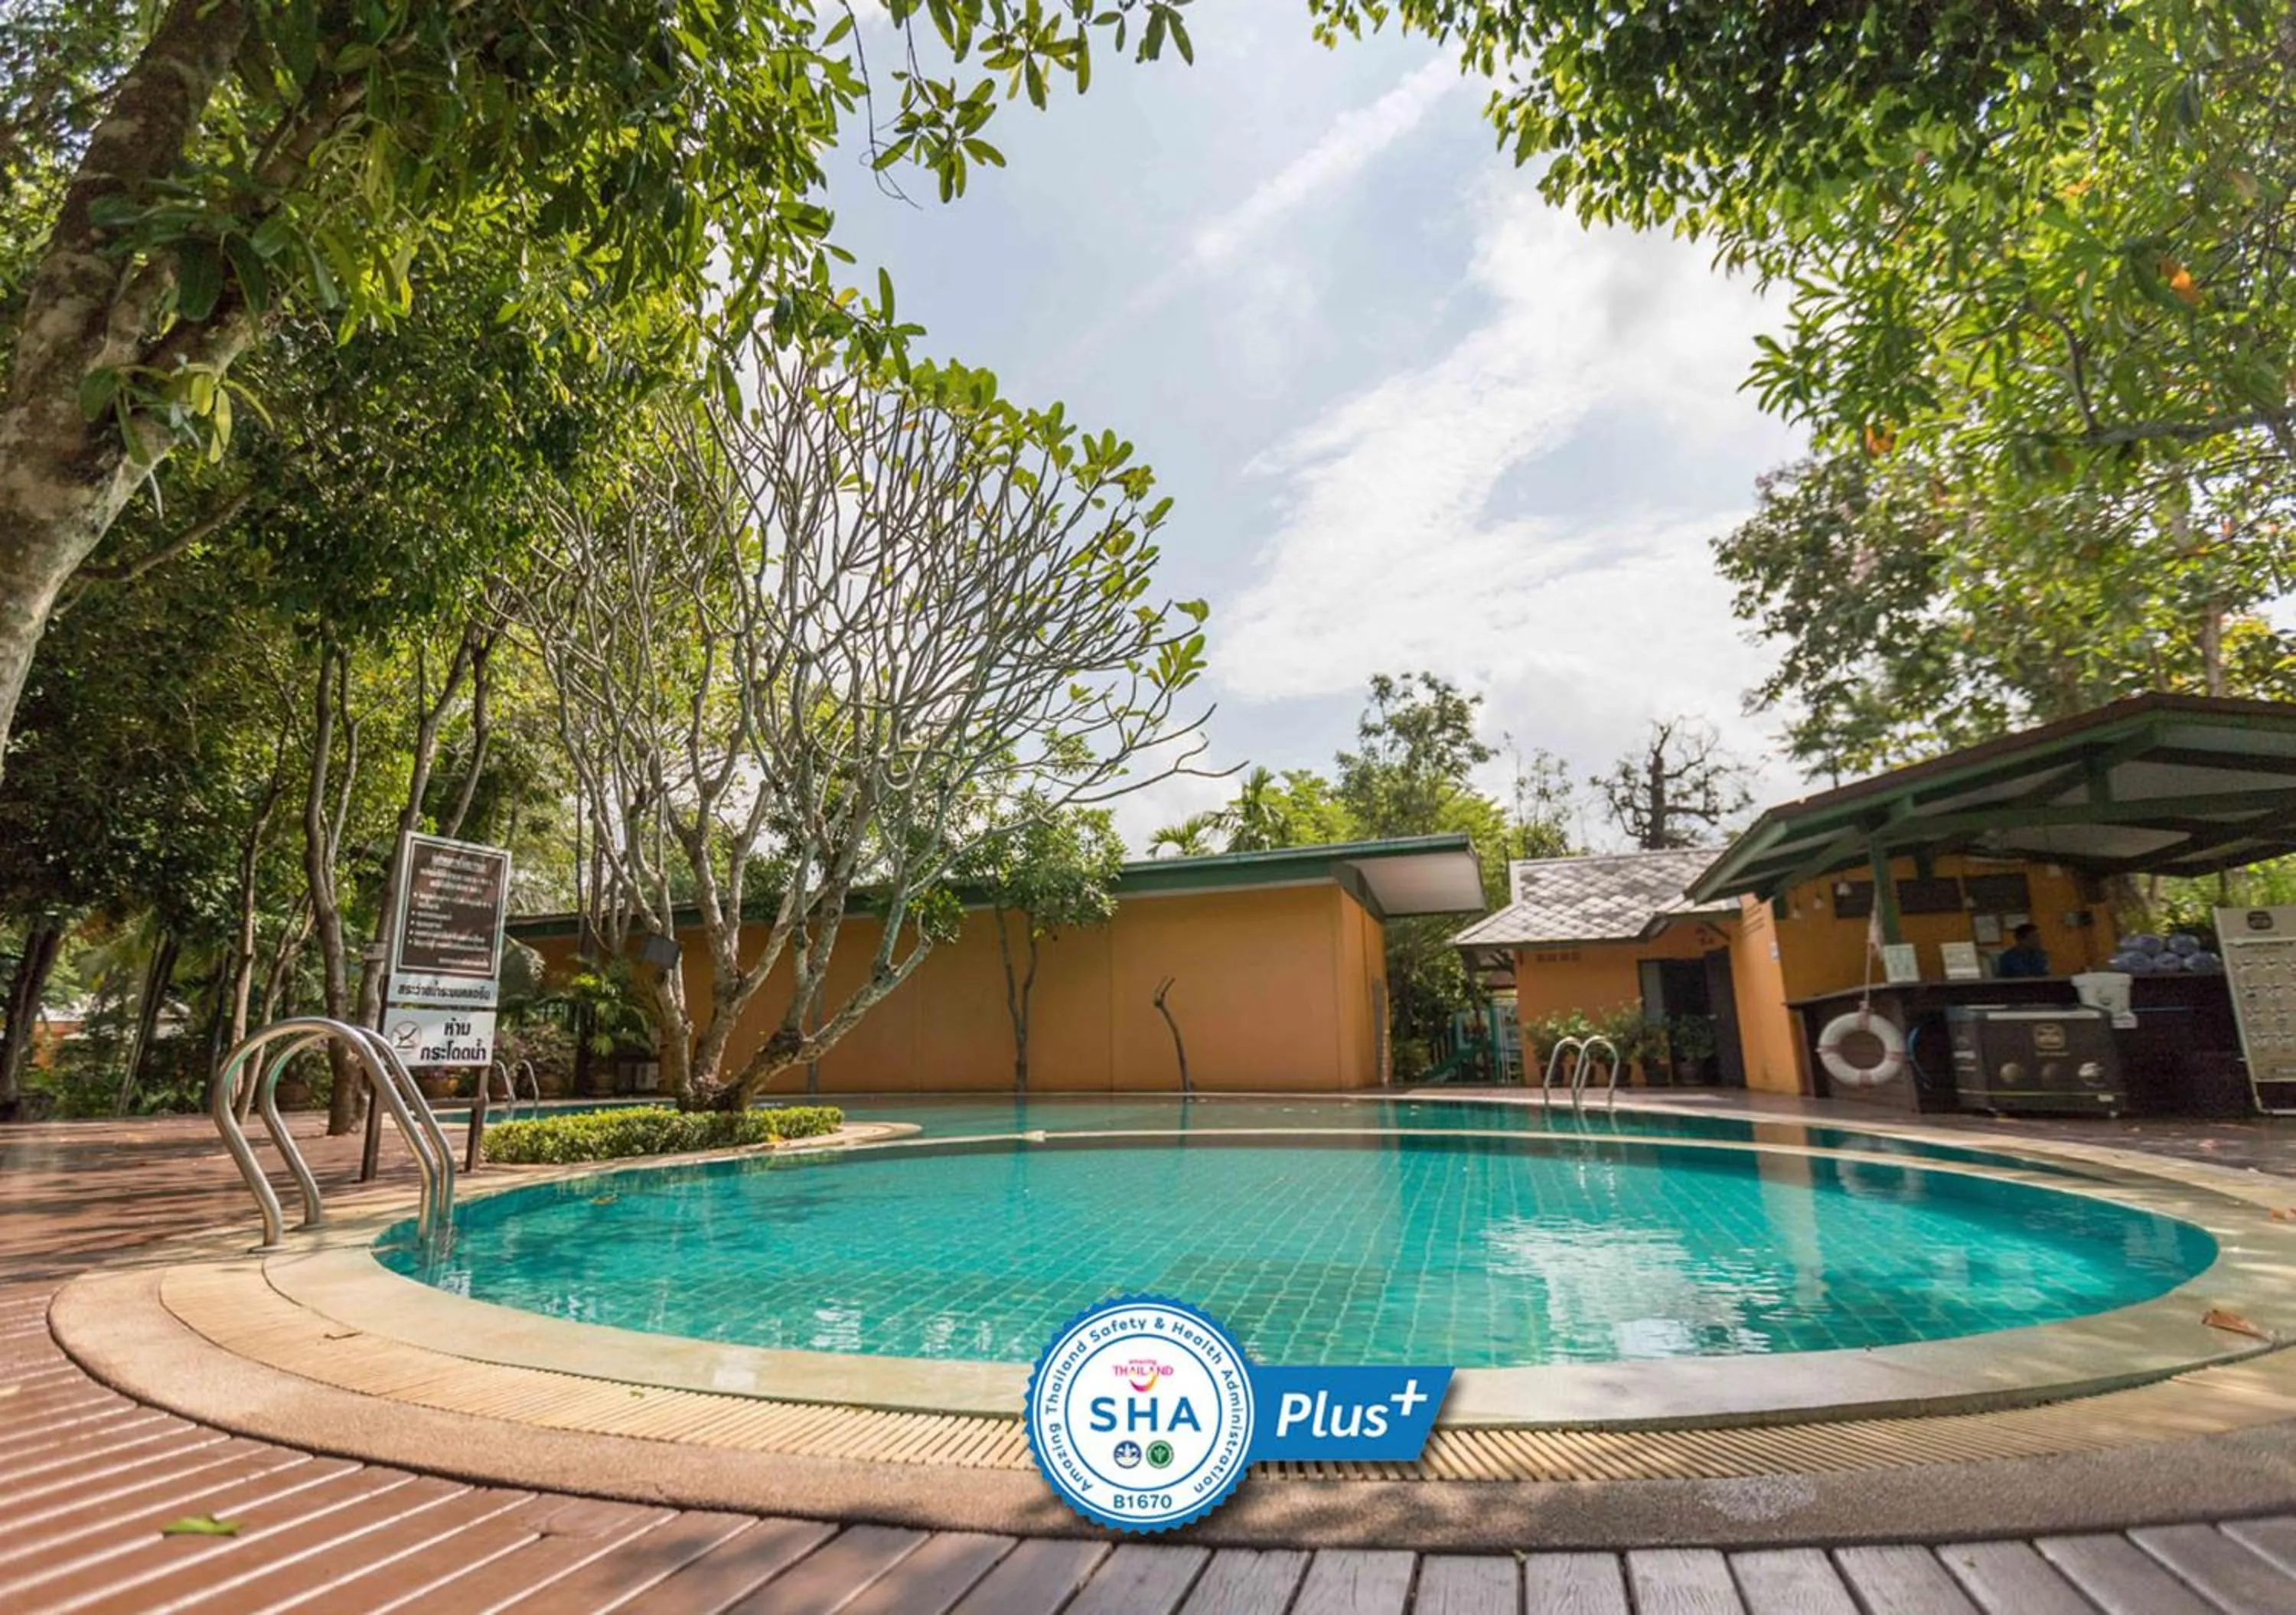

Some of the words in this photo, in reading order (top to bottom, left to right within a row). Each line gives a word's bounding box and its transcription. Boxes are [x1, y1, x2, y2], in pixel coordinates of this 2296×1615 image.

[444, 1017, 471, 1036] ห้าม
[420, 1038, 486, 1060] กระโดดน้ำ
